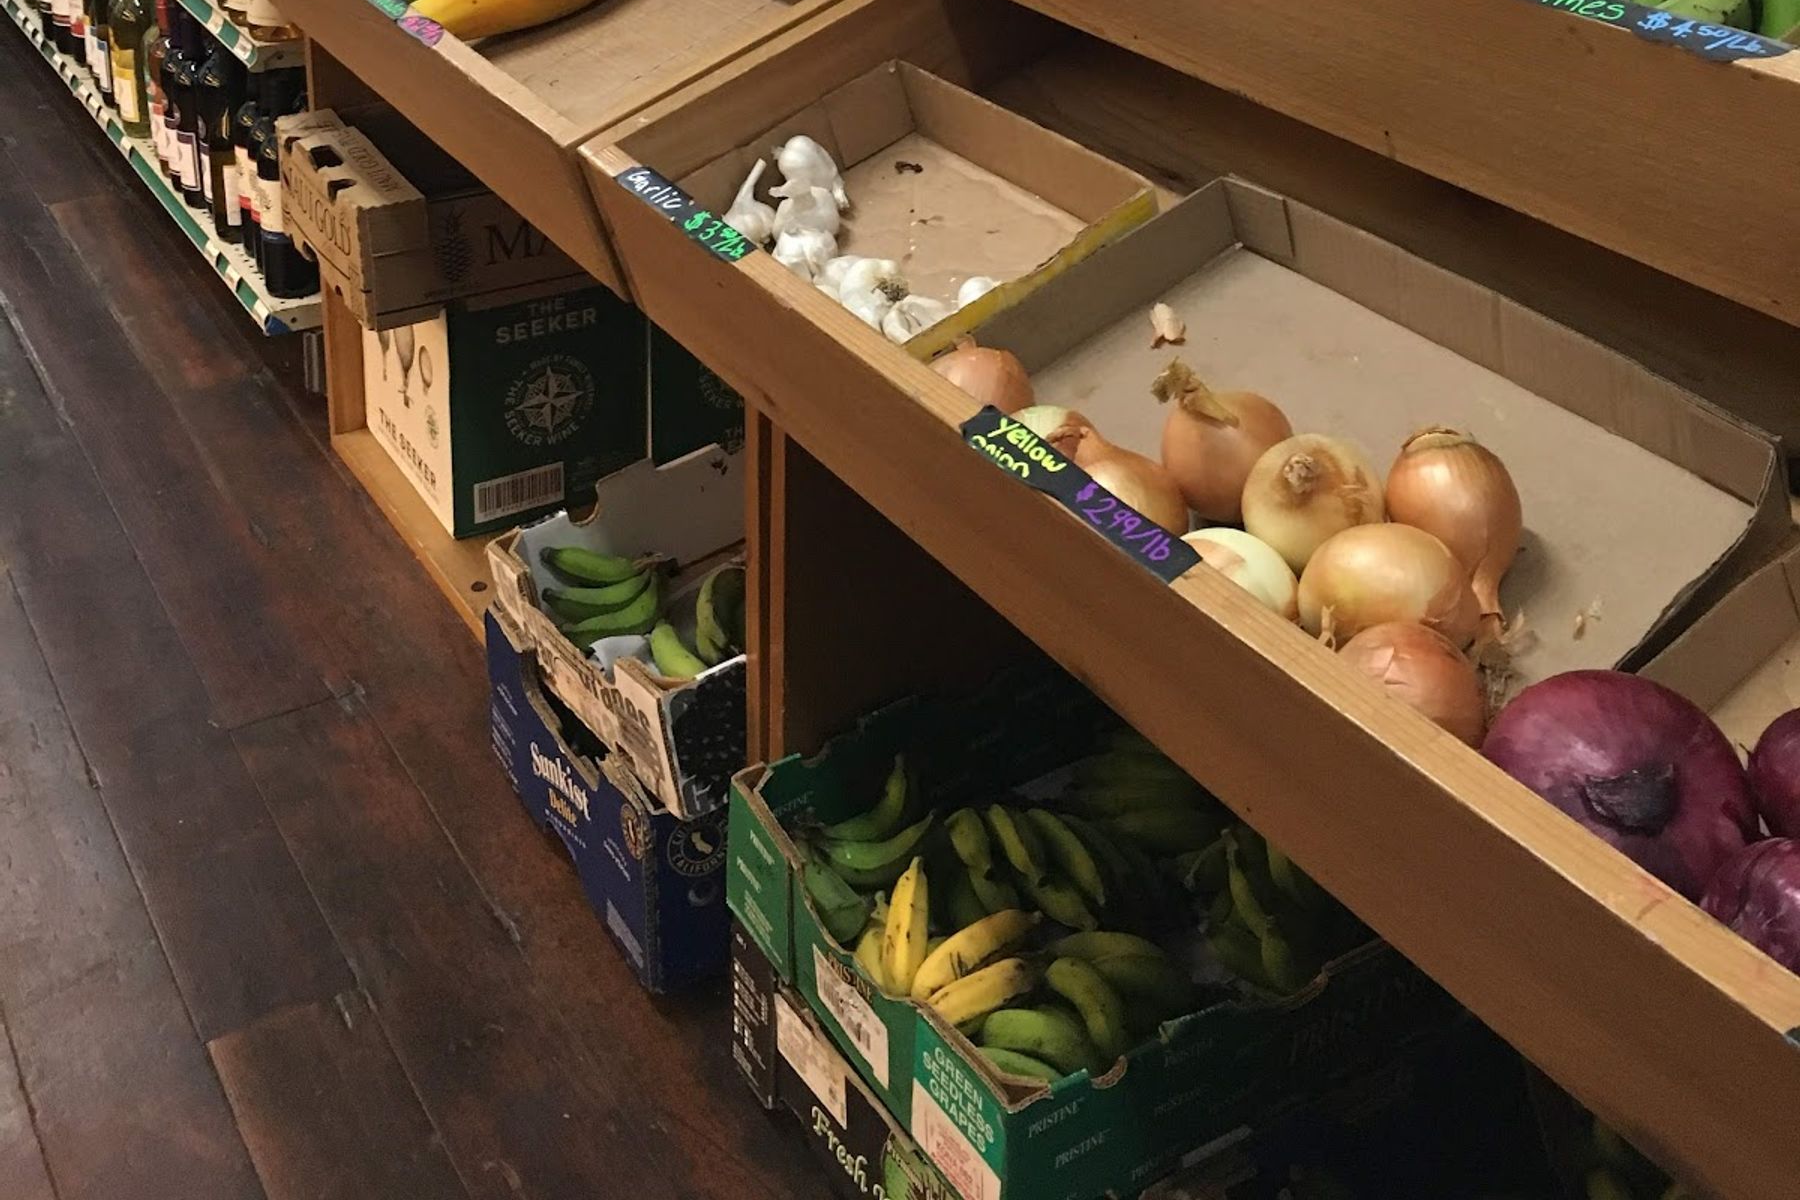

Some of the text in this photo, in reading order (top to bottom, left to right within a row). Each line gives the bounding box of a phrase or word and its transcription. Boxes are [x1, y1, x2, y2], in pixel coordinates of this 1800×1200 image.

[626, 170, 682, 210] Garlic
[314, 199, 351, 256] GOLD
[495, 307, 598, 345] SEEKER
[527, 296, 566, 317] THE
[379, 407, 437, 490] THE SEEKER
[530, 741, 592, 822] Sunkist
[922, 1051, 994, 1144] SEEDLESS
[934, 1046, 983, 1112] GREEN
[929, 1078, 986, 1154] GRAPES
[1027, 1096, 1085, 1139] PRISTINE
[811, 1105, 868, 1193] Fresh
[1055, 1127, 1111, 1169] PRISTINE
